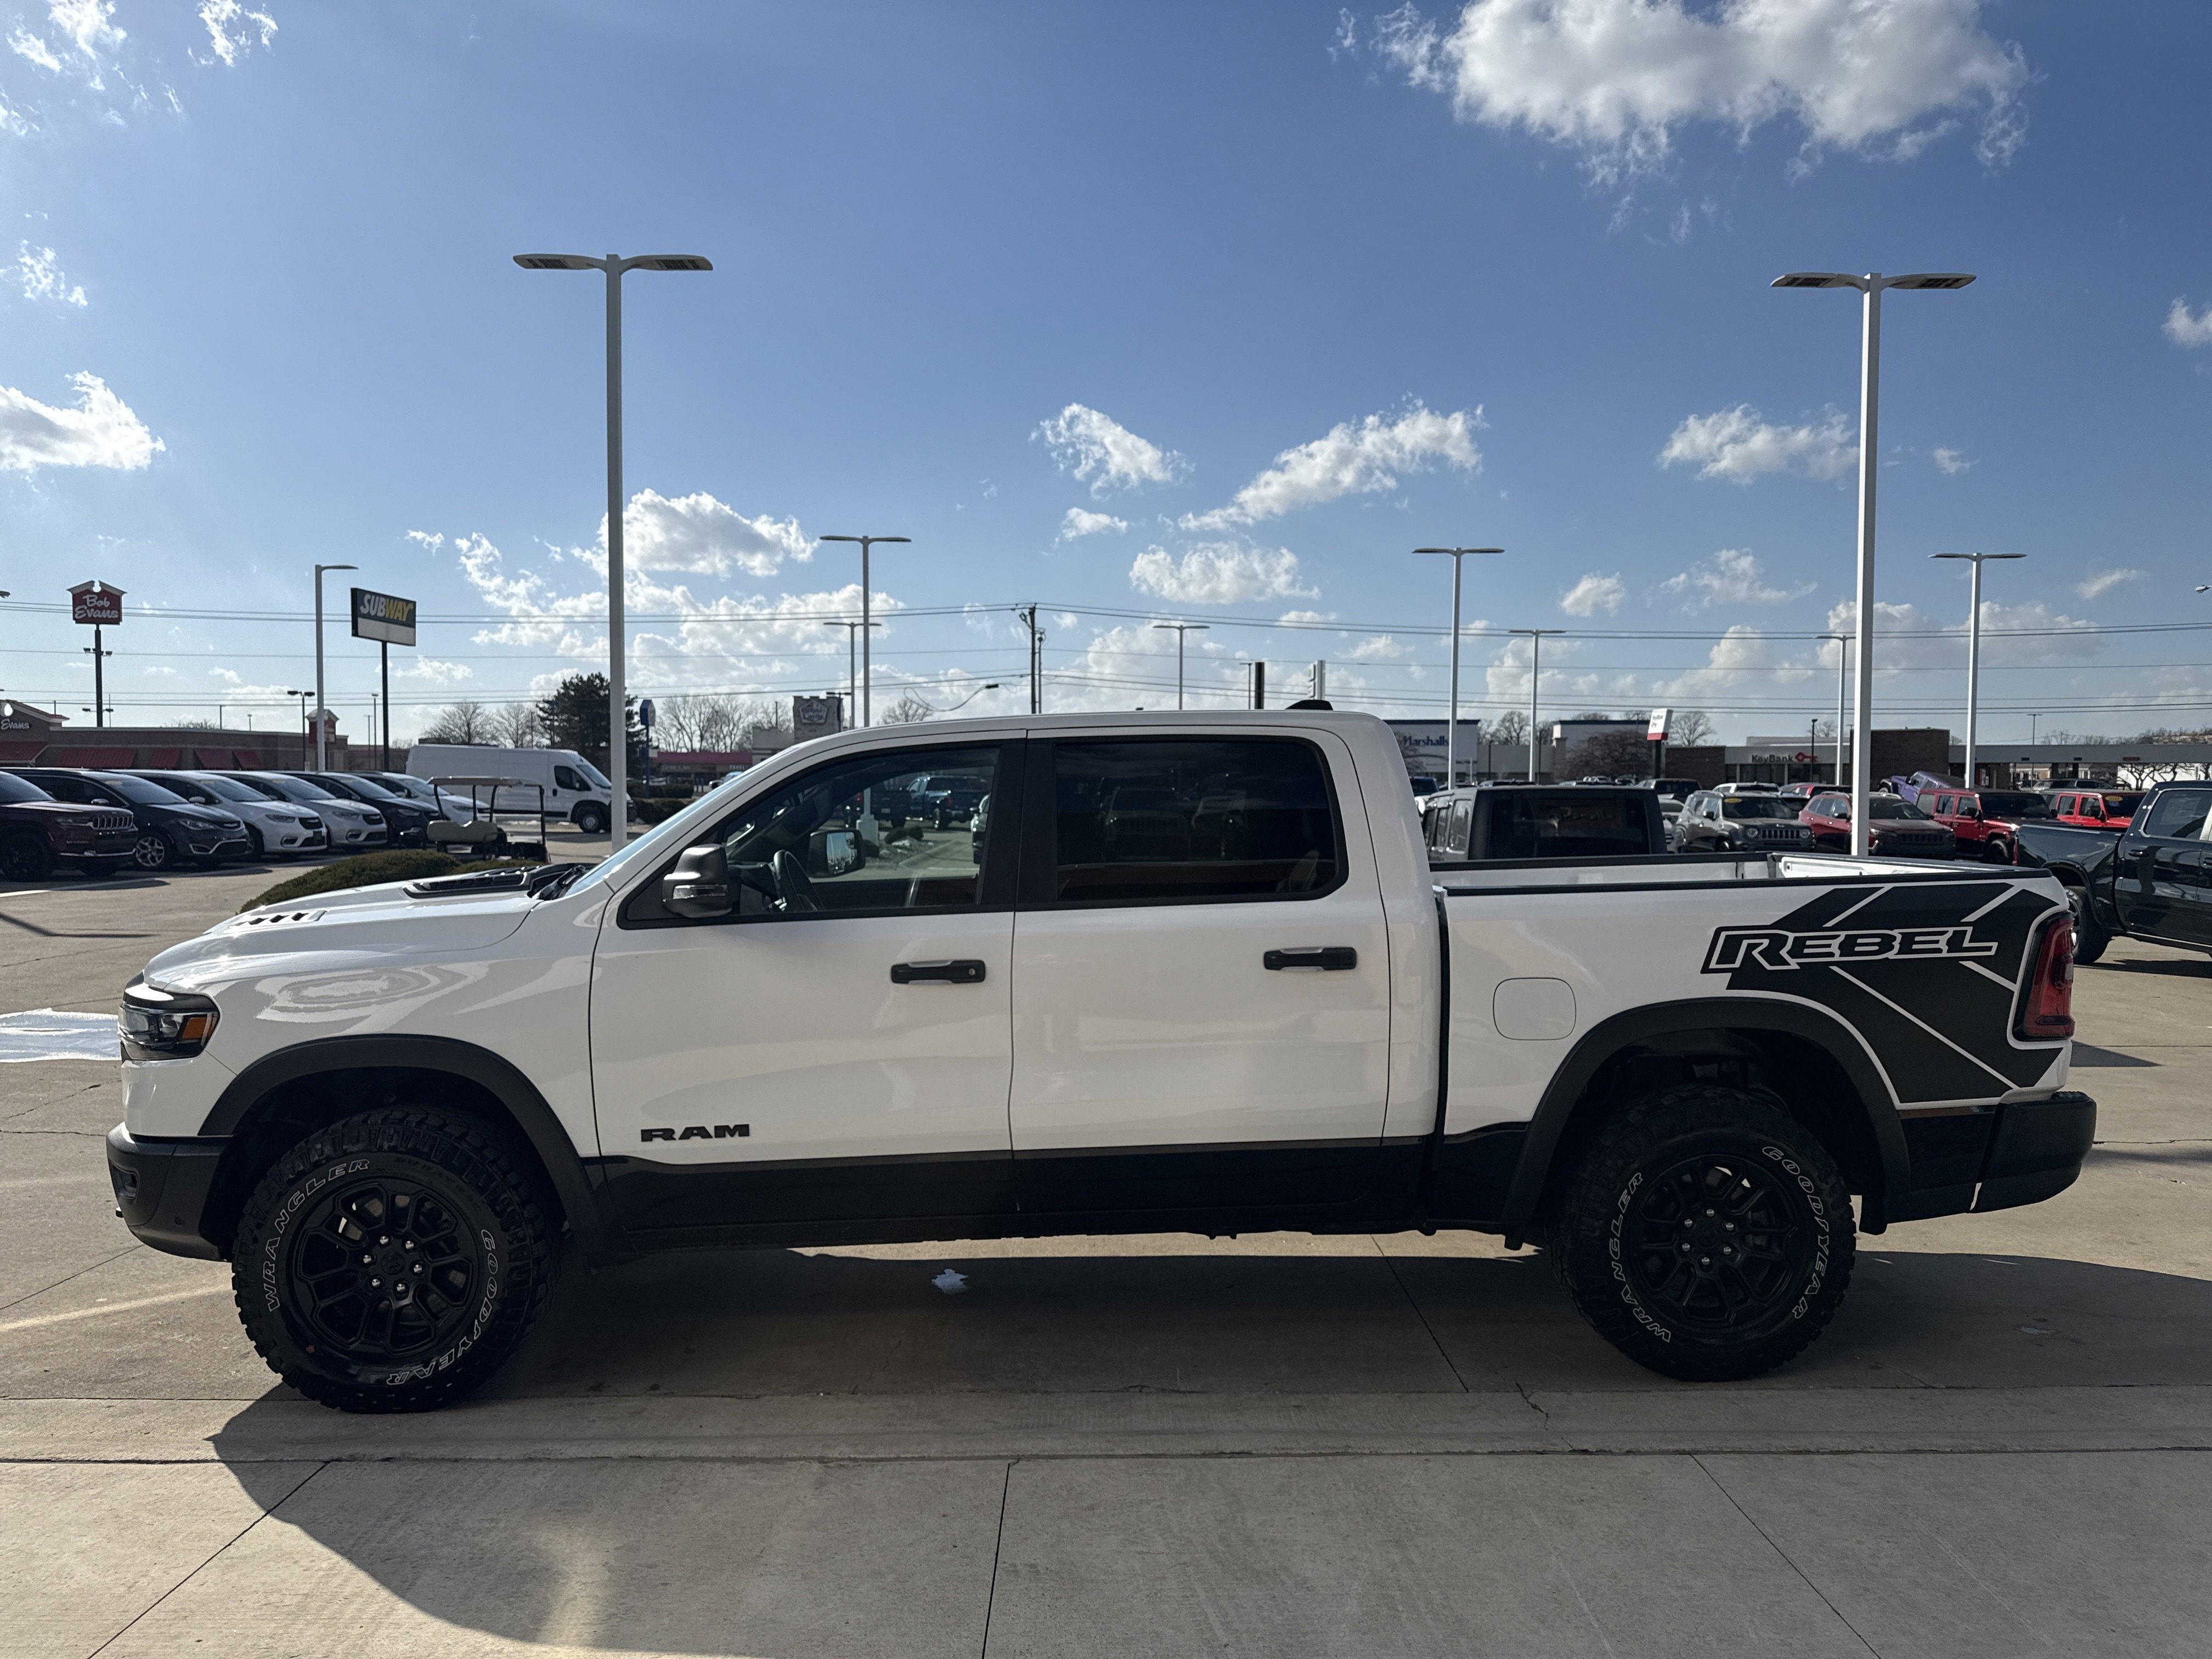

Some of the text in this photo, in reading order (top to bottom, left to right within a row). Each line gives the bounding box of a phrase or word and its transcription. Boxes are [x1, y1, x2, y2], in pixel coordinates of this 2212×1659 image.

[82, 594, 110, 607] Bob
[360, 594, 414, 621] SUBWAY
[75, 605, 119, 619] Evans
[1, 718, 30, 730] Evans
[1400, 736, 1448, 746] Marshalls
[1752, 754, 1793, 763] KeyBank
[1708, 926, 1998, 970] REBEL
[641, 1124, 750, 1142] RAM
[263, 1159, 370, 1311] WRANGLER
[1763, 1147, 1829, 1318] GOODYEAR
[1610, 1172, 1671, 1342] WRANGLER
[387, 1229, 498, 1385] GOODYEAR
